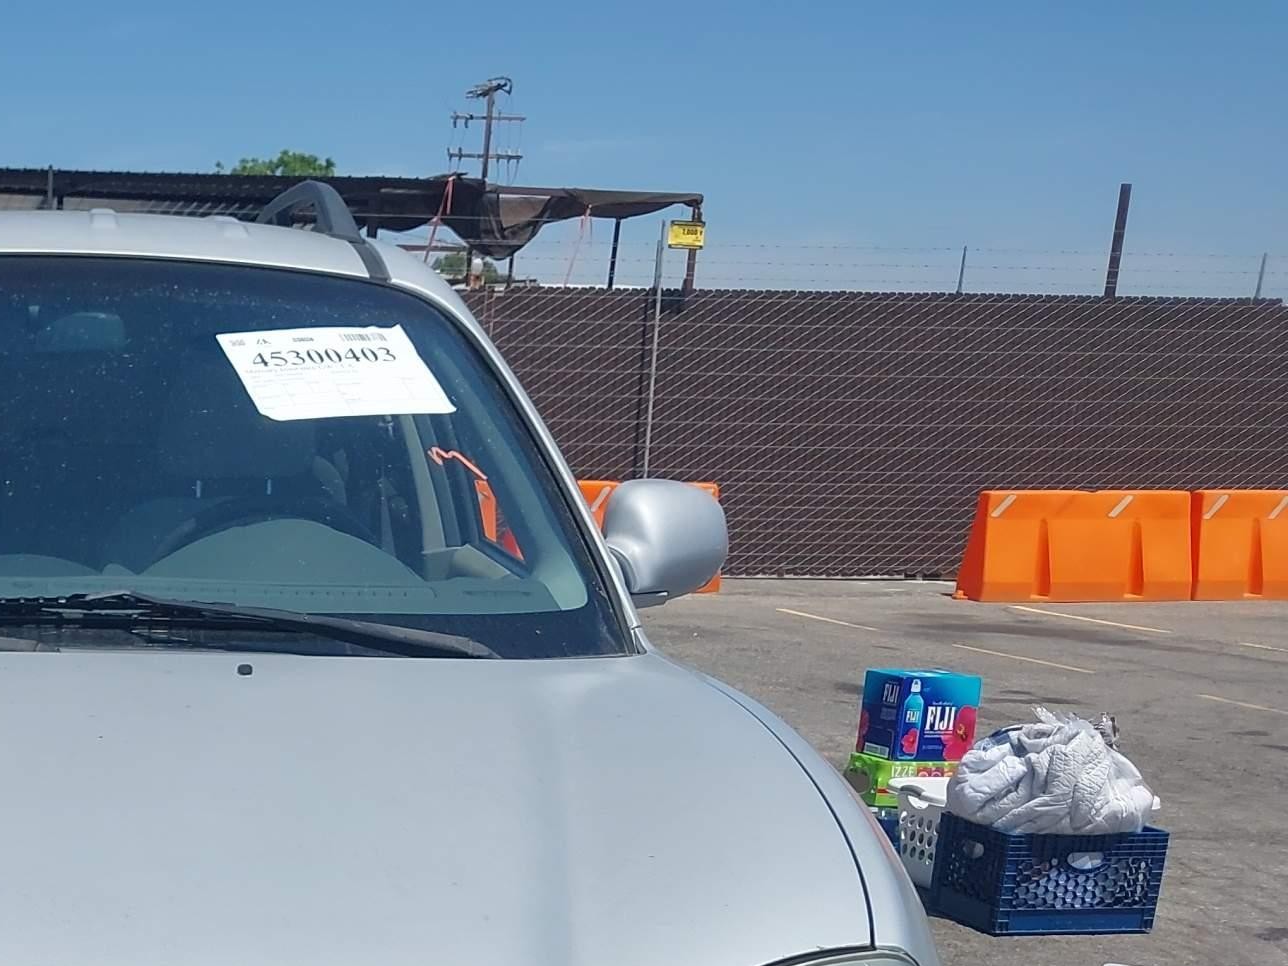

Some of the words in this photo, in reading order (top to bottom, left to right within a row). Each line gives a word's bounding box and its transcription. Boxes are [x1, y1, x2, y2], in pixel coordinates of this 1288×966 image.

[253, 347, 396, 367] 45300403
[883, 684, 900, 704] FIJI
[925, 706, 956, 730] FIJI
